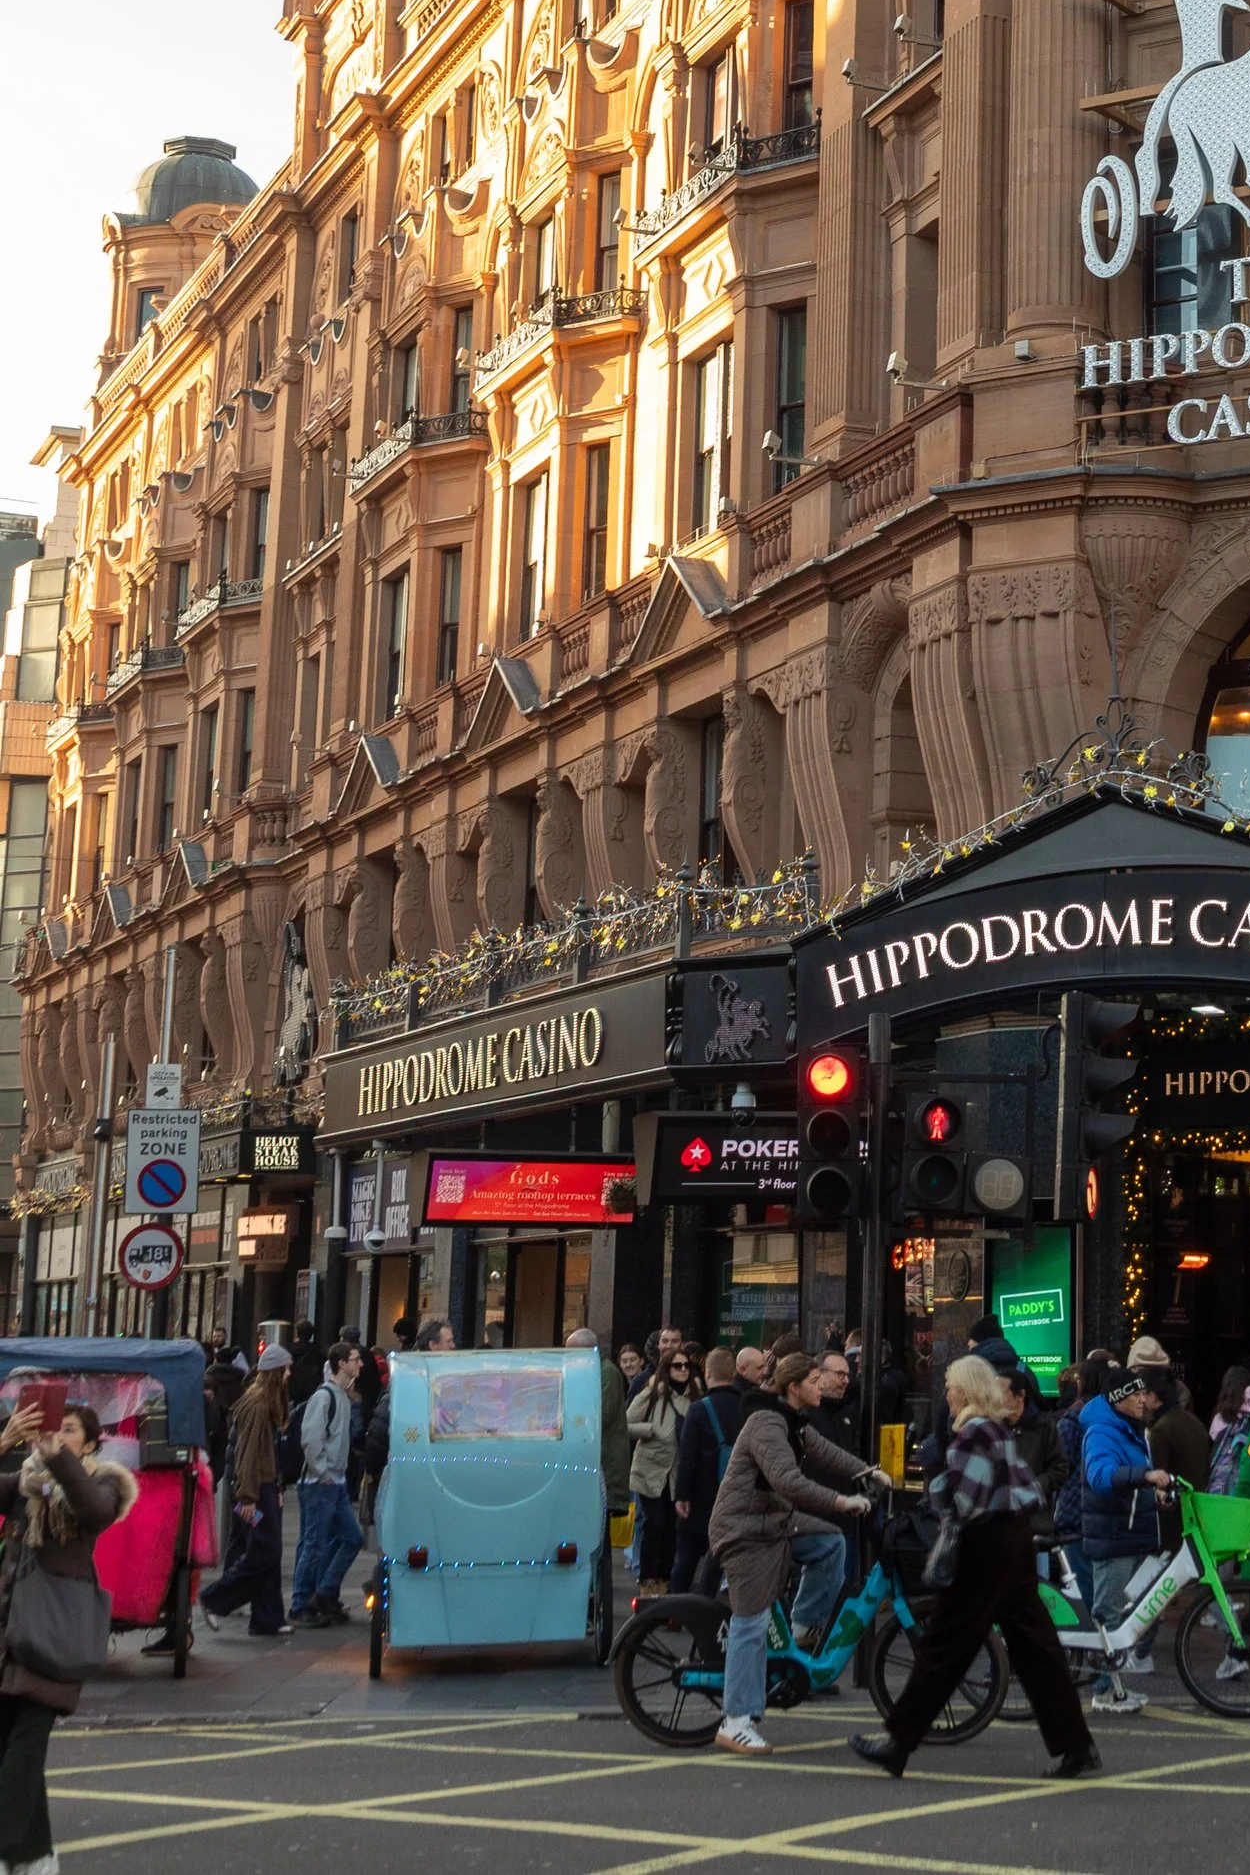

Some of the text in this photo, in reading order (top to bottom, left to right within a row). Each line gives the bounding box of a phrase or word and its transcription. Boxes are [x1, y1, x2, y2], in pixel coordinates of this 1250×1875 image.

[825, 898, 1174, 1009] HIPPODROME
[357, 1007, 602, 1117] HIPPODROME CASINO
[132, 1114, 197, 1125] Restricted
[140, 1128, 187, 1140] parking
[255, 1136, 299, 1147] HELIOT
[721, 1139, 799, 1157] POKER
[140, 1143, 187, 1155] ZONE
[255, 1146, 298, 1156] STEAK
[255, 1155, 299, 1166] HOUSE
[720, 1160, 736, 1171] AT
[744, 1160, 770, 1171] THE
[509, 1168, 560, 1185] Gods
[758, 1178, 797, 1189] 3rd floor
[352, 1181, 375, 1202] MAGIC
[391, 1169, 407, 1203] BOX
[471, 1189, 597, 1202] Amazing rooftop terraces
[351, 1201, 372, 1222] MIKE
[385, 1205, 409, 1238] OFFICE
[1009, 1300, 1055, 1316] PADDY'S
[1015, 1318, 1050, 1327] SPORTSBOOK
[1135, 1576, 1177, 1625] Lime
